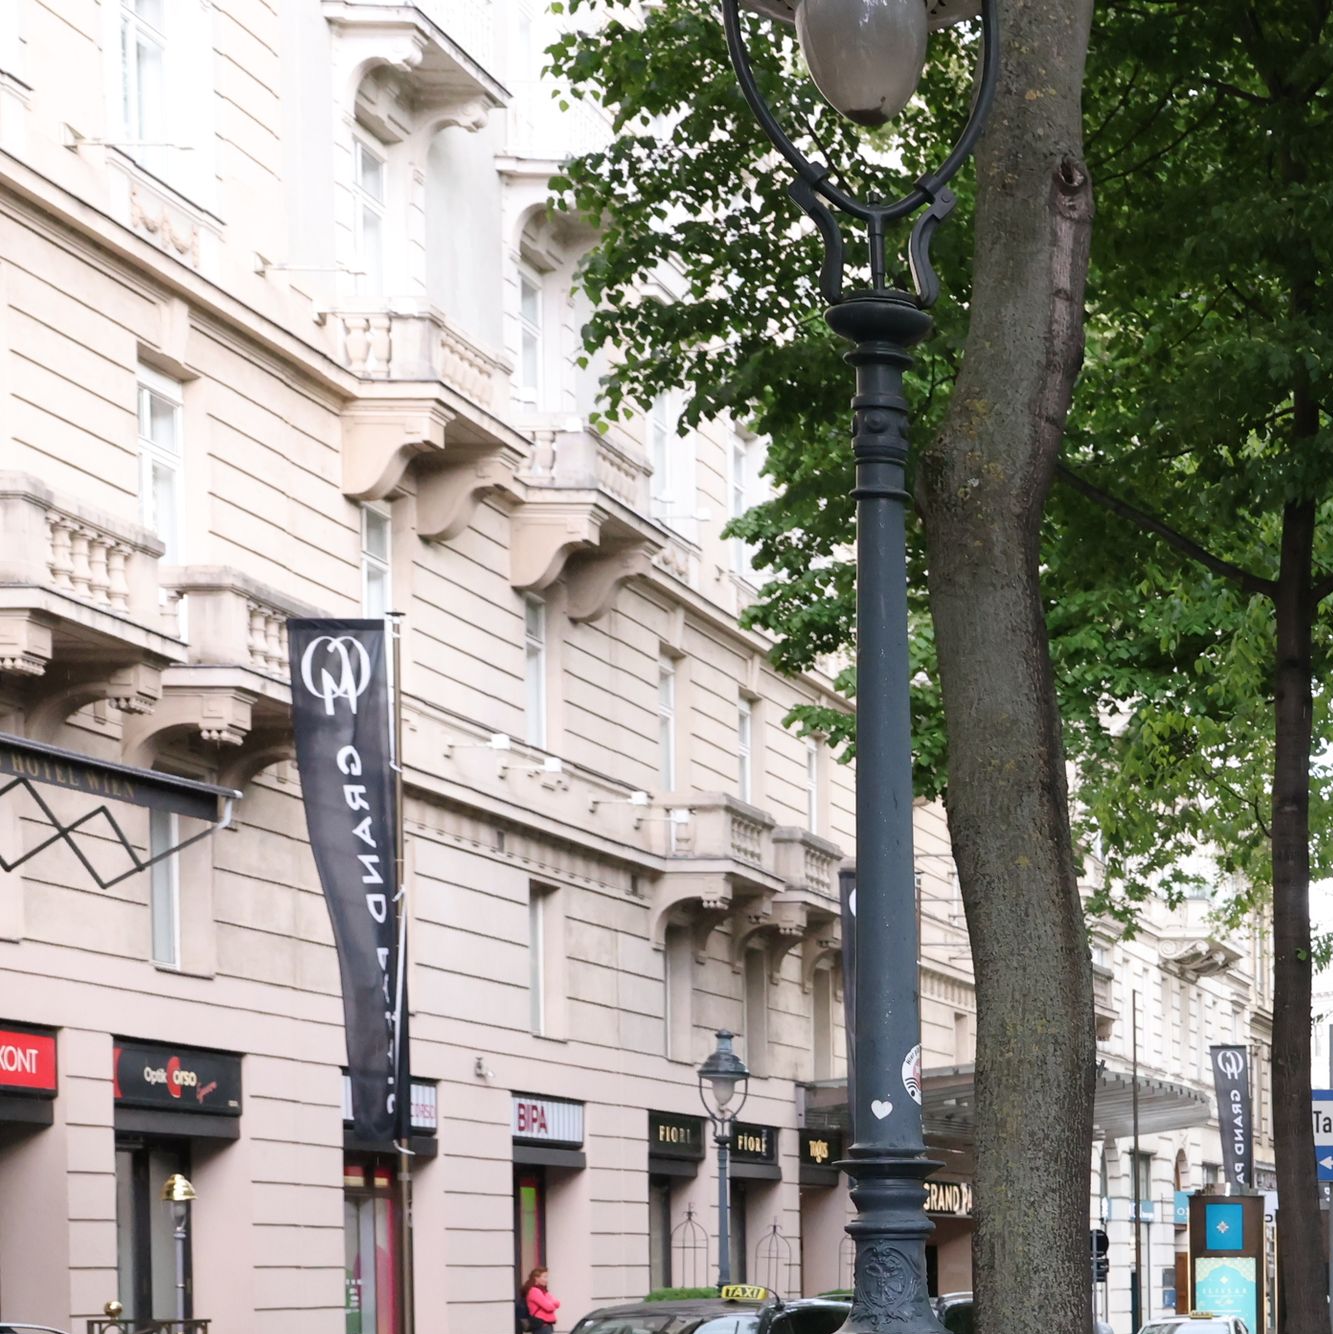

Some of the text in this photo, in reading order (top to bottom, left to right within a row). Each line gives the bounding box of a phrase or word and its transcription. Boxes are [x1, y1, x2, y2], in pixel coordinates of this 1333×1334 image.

[143, 1066, 168, 1086] Optik
[517, 1102, 548, 1134] BIPA
[725, 1286, 761, 1298] TAXI
